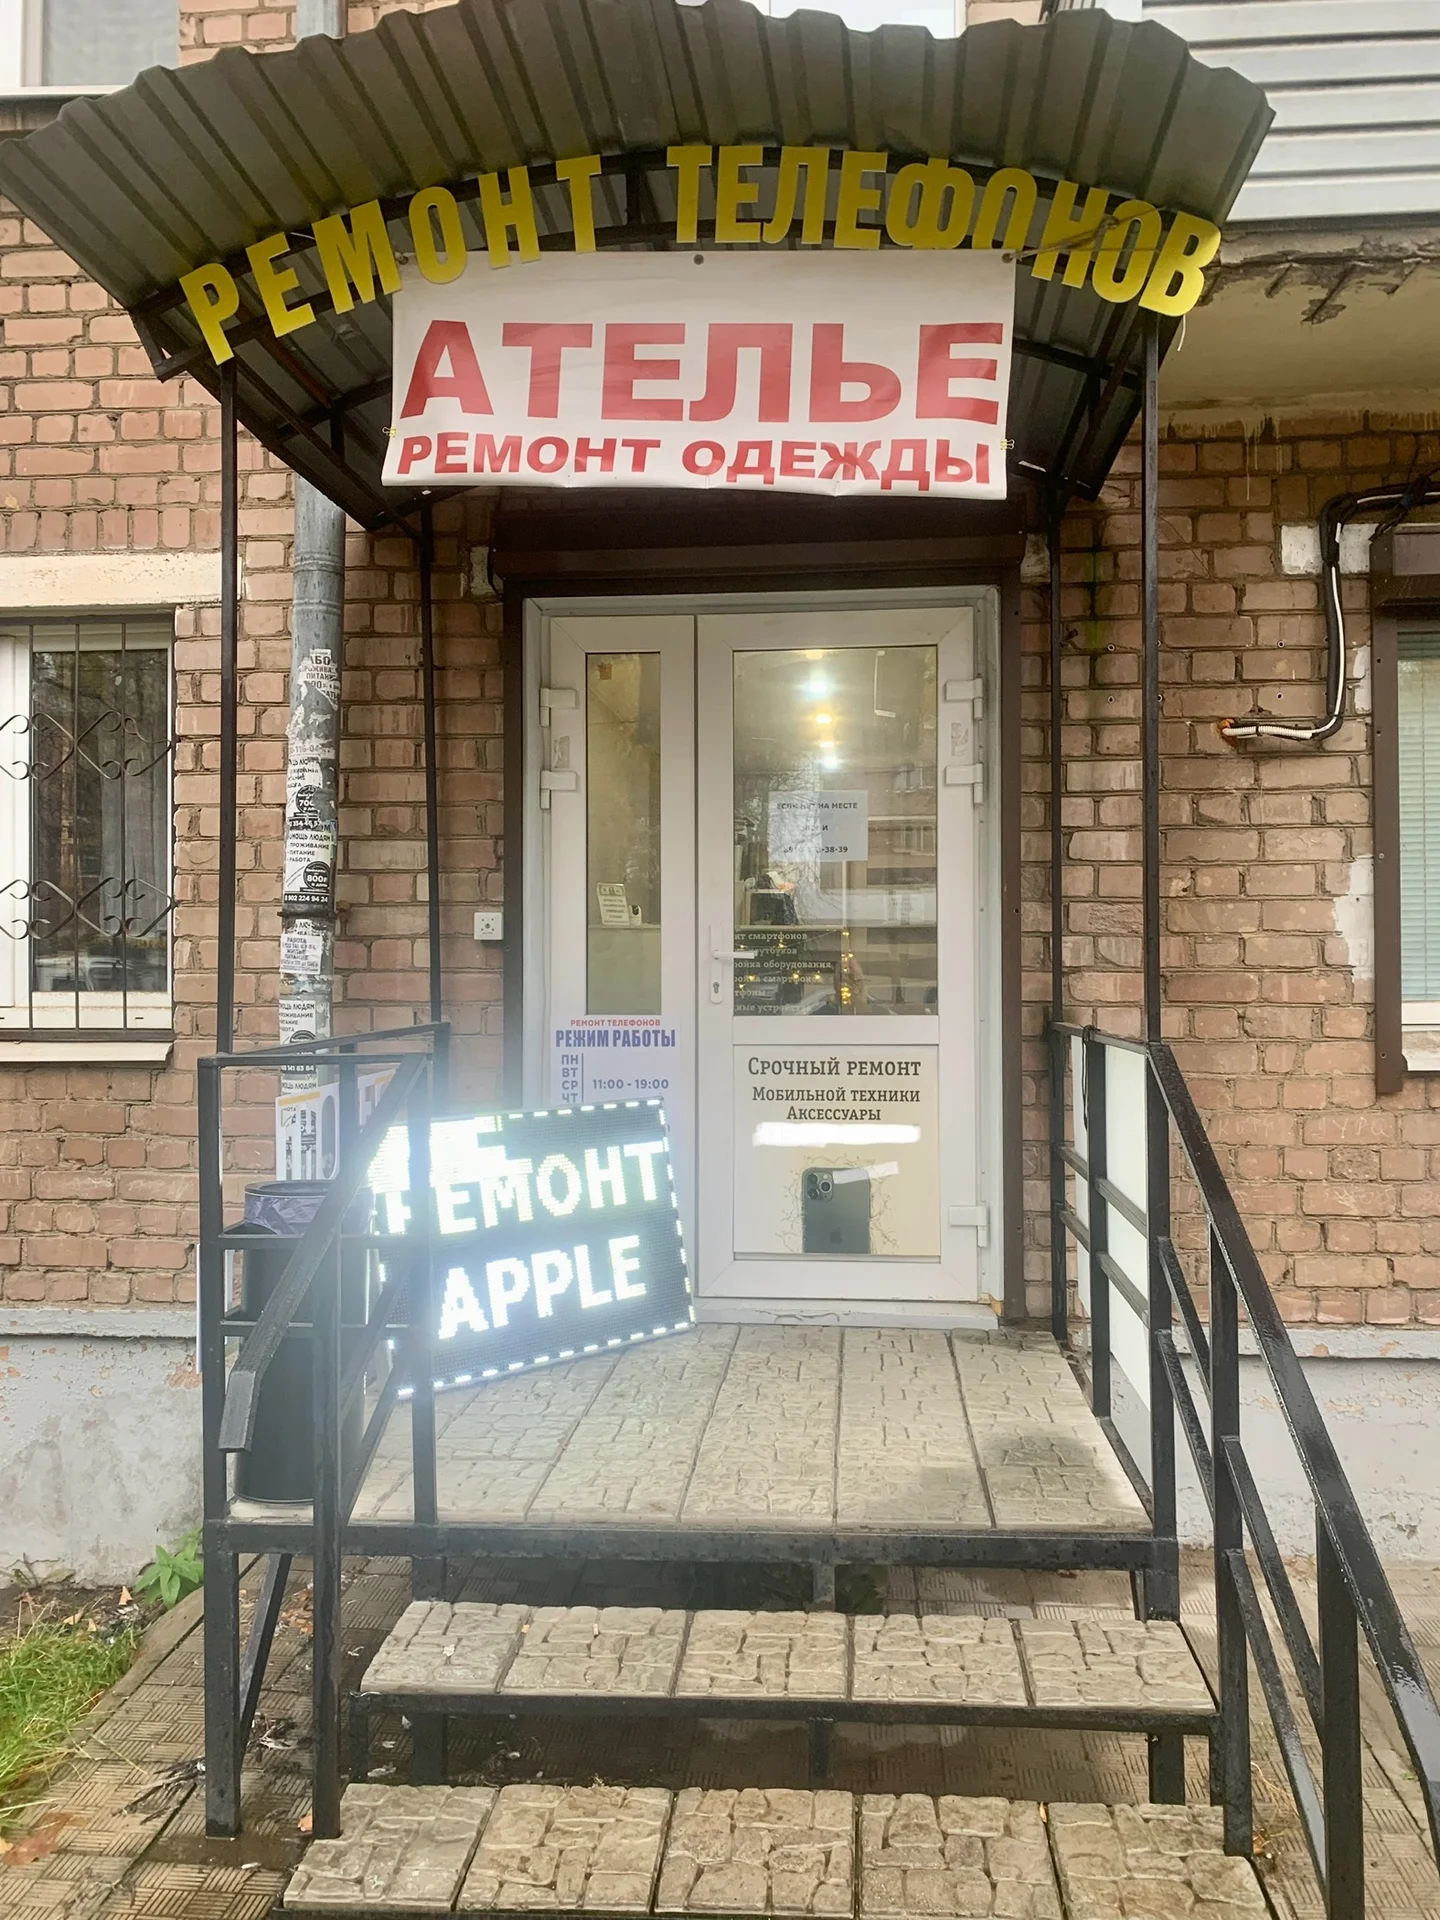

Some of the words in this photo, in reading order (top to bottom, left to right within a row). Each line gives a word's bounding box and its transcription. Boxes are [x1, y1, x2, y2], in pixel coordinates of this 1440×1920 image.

[178, 153, 602, 366] РЕМОНТ
[665, 143, 1222, 318] ТЕЛЕФОНОВ
[399, 319, 1004, 425] АТЕЛЬЕ
[396, 432, 662, 476] РЕМОНТ
[681, 438, 990, 492] ОДЕЖДЫ
[570, 1019, 605, 1027] РЕМОНТ
[607, 1019, 661, 1027] ТЕЛЕФОНОВ
[555, 1029, 609, 1048] РЕЖИМ
[612, 1029, 676, 1048] РАБОТЫ
[561, 1054, 579, 1065] ПН
[561, 1067, 579, 1078] ВТ
[561, 1080, 579, 1090] СР
[592, 1079, 624, 1090] 11:00
[635, 1079, 669, 1090] 19:00
[561, 1092, 579, 1103] ЧТ
[437, 1234, 648, 1341] APPLE
